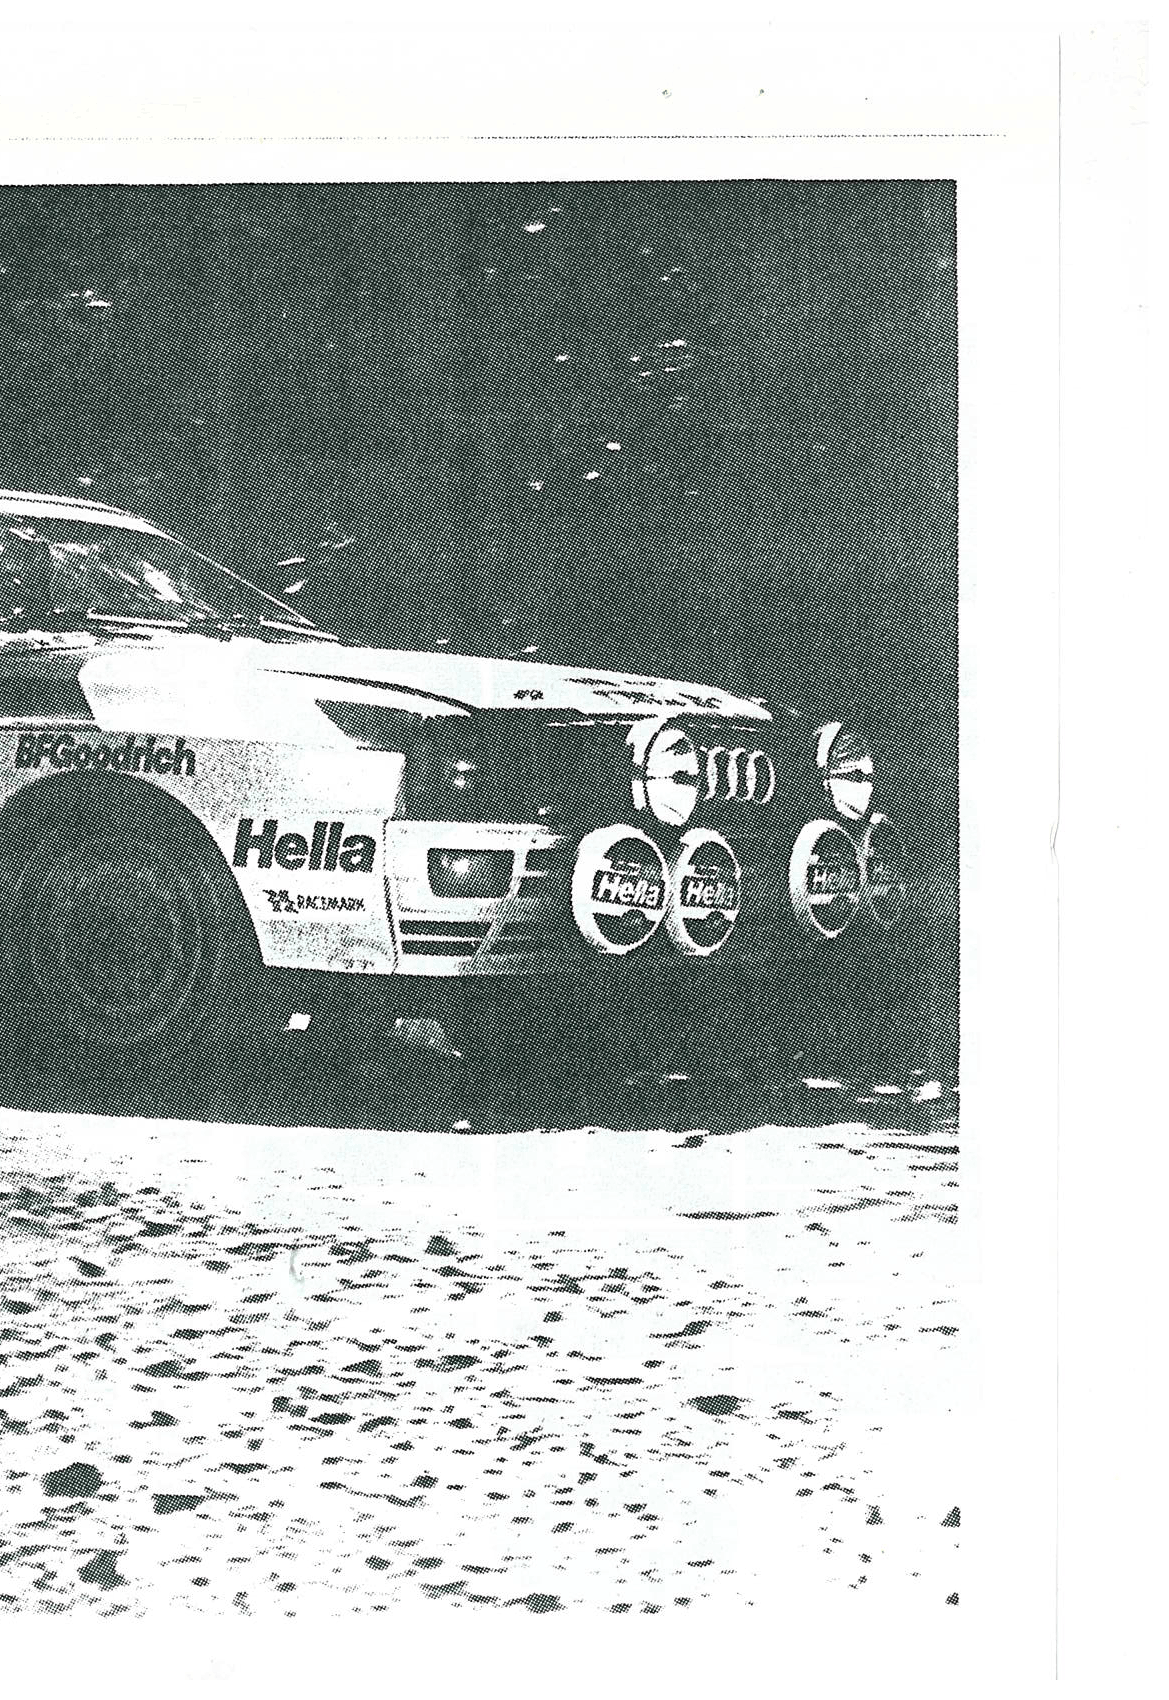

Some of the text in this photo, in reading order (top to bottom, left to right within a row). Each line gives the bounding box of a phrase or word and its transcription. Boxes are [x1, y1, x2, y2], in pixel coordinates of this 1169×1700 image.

[16, 732, 197, 776] BFGoodrich
[233, 817, 377, 874] Hella
[598, 874, 660, 906] Hella
[686, 880, 734, 906] Hella
